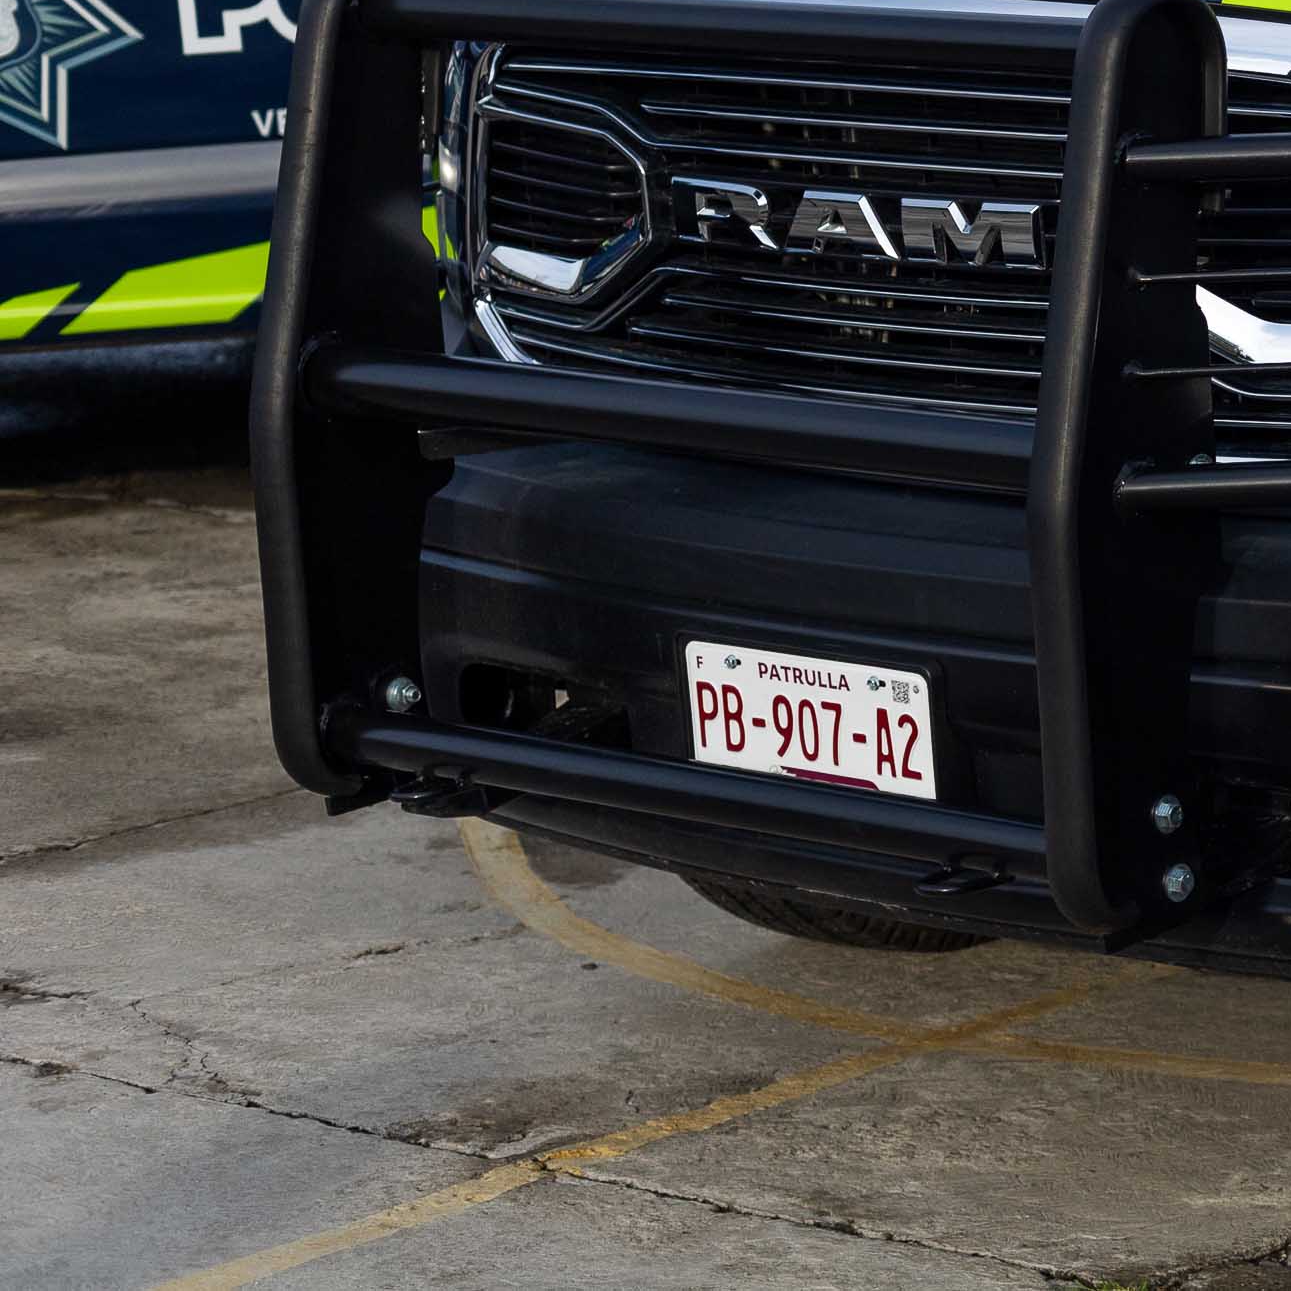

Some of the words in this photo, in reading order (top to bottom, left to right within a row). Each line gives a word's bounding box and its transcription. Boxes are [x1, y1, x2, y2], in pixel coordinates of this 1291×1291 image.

[671, 176, 1049, 270] RAM
[757, 661, 850, 691] PATRULLA
[696, 680, 922, 781] PB-907-A2
